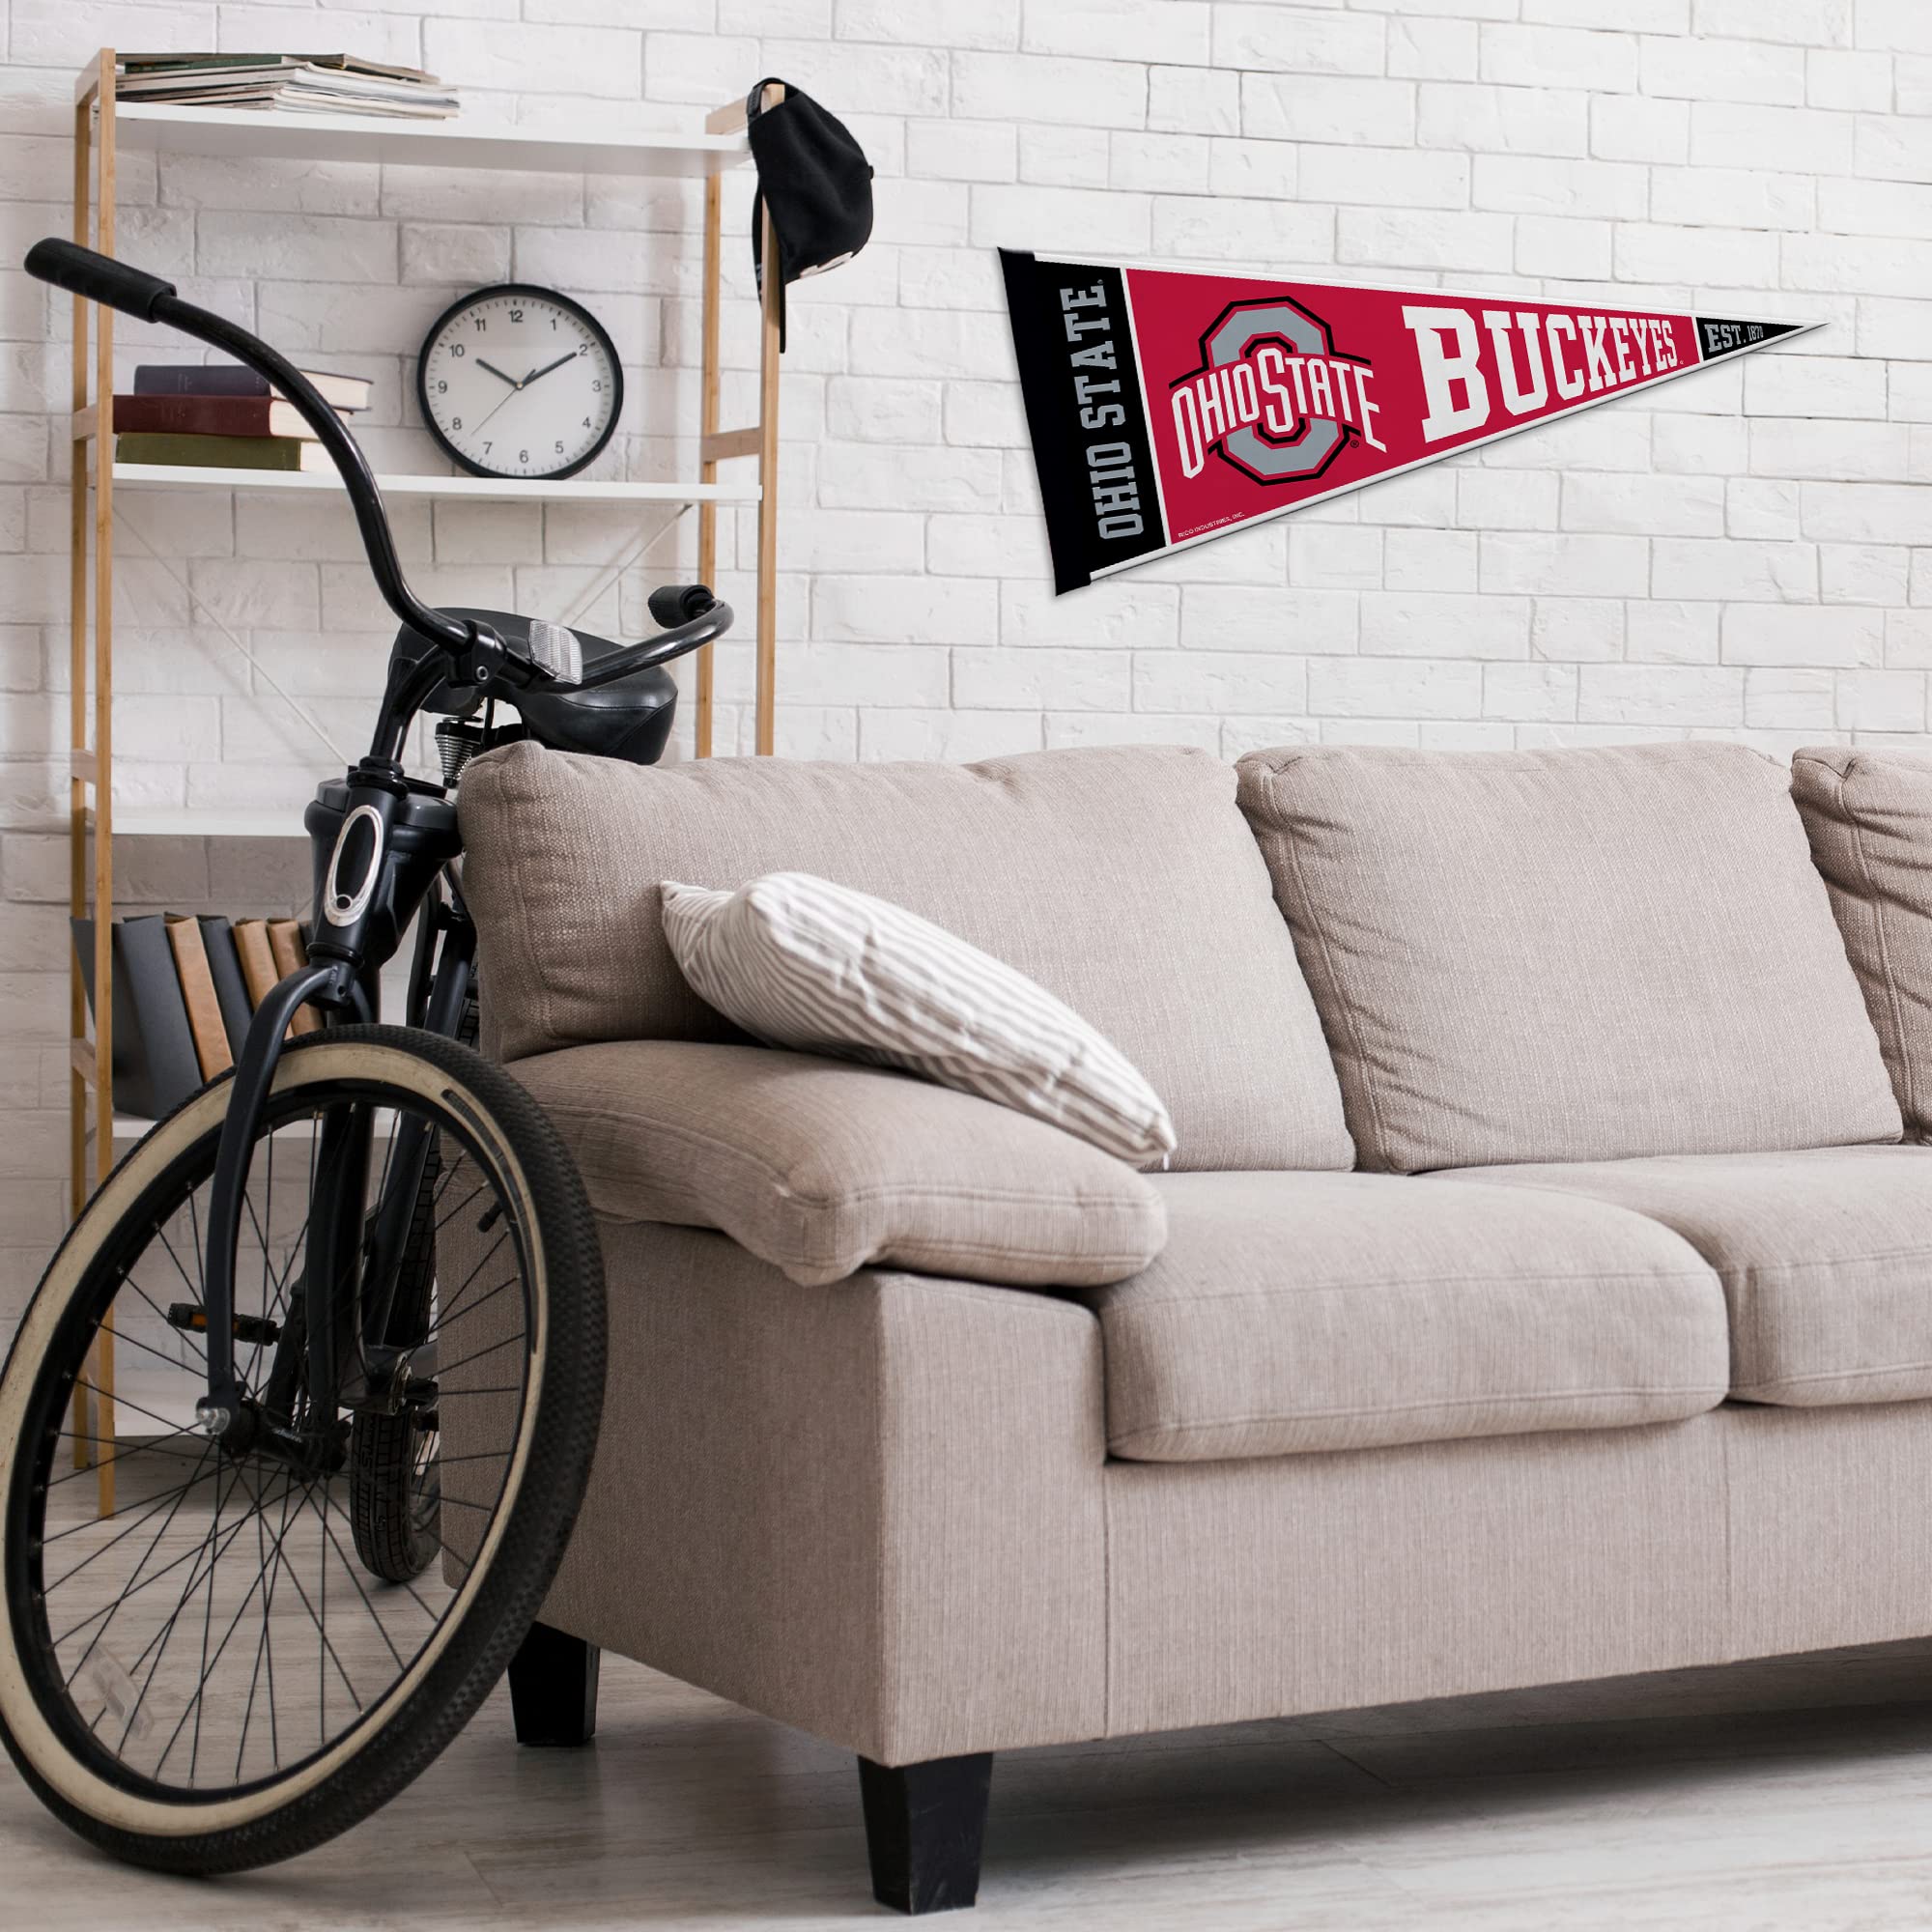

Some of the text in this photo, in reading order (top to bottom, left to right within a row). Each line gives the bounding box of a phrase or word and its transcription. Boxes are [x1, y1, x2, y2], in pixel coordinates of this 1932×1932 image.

[509, 310, 523, 323] 12
[474, 319, 486, 331] 11
[551, 319, 556, 330] 1
[1704, 323, 1764, 354] EST. 1870
[449, 344, 465, 357] 10
[579, 344, 588, 356] 2
[1402, 305, 1678, 443] BUCKEYES
[438, 381, 447, 393] 9
[592, 380, 601, 392] 3
[452, 417, 462, 431] 8
[582, 417, 591, 428] 4
[483, 441, 492, 455] 7
[554, 440, 564, 454] 5
[519, 450, 528, 463] 6
[1086, 440, 1144, 540] OHIO
